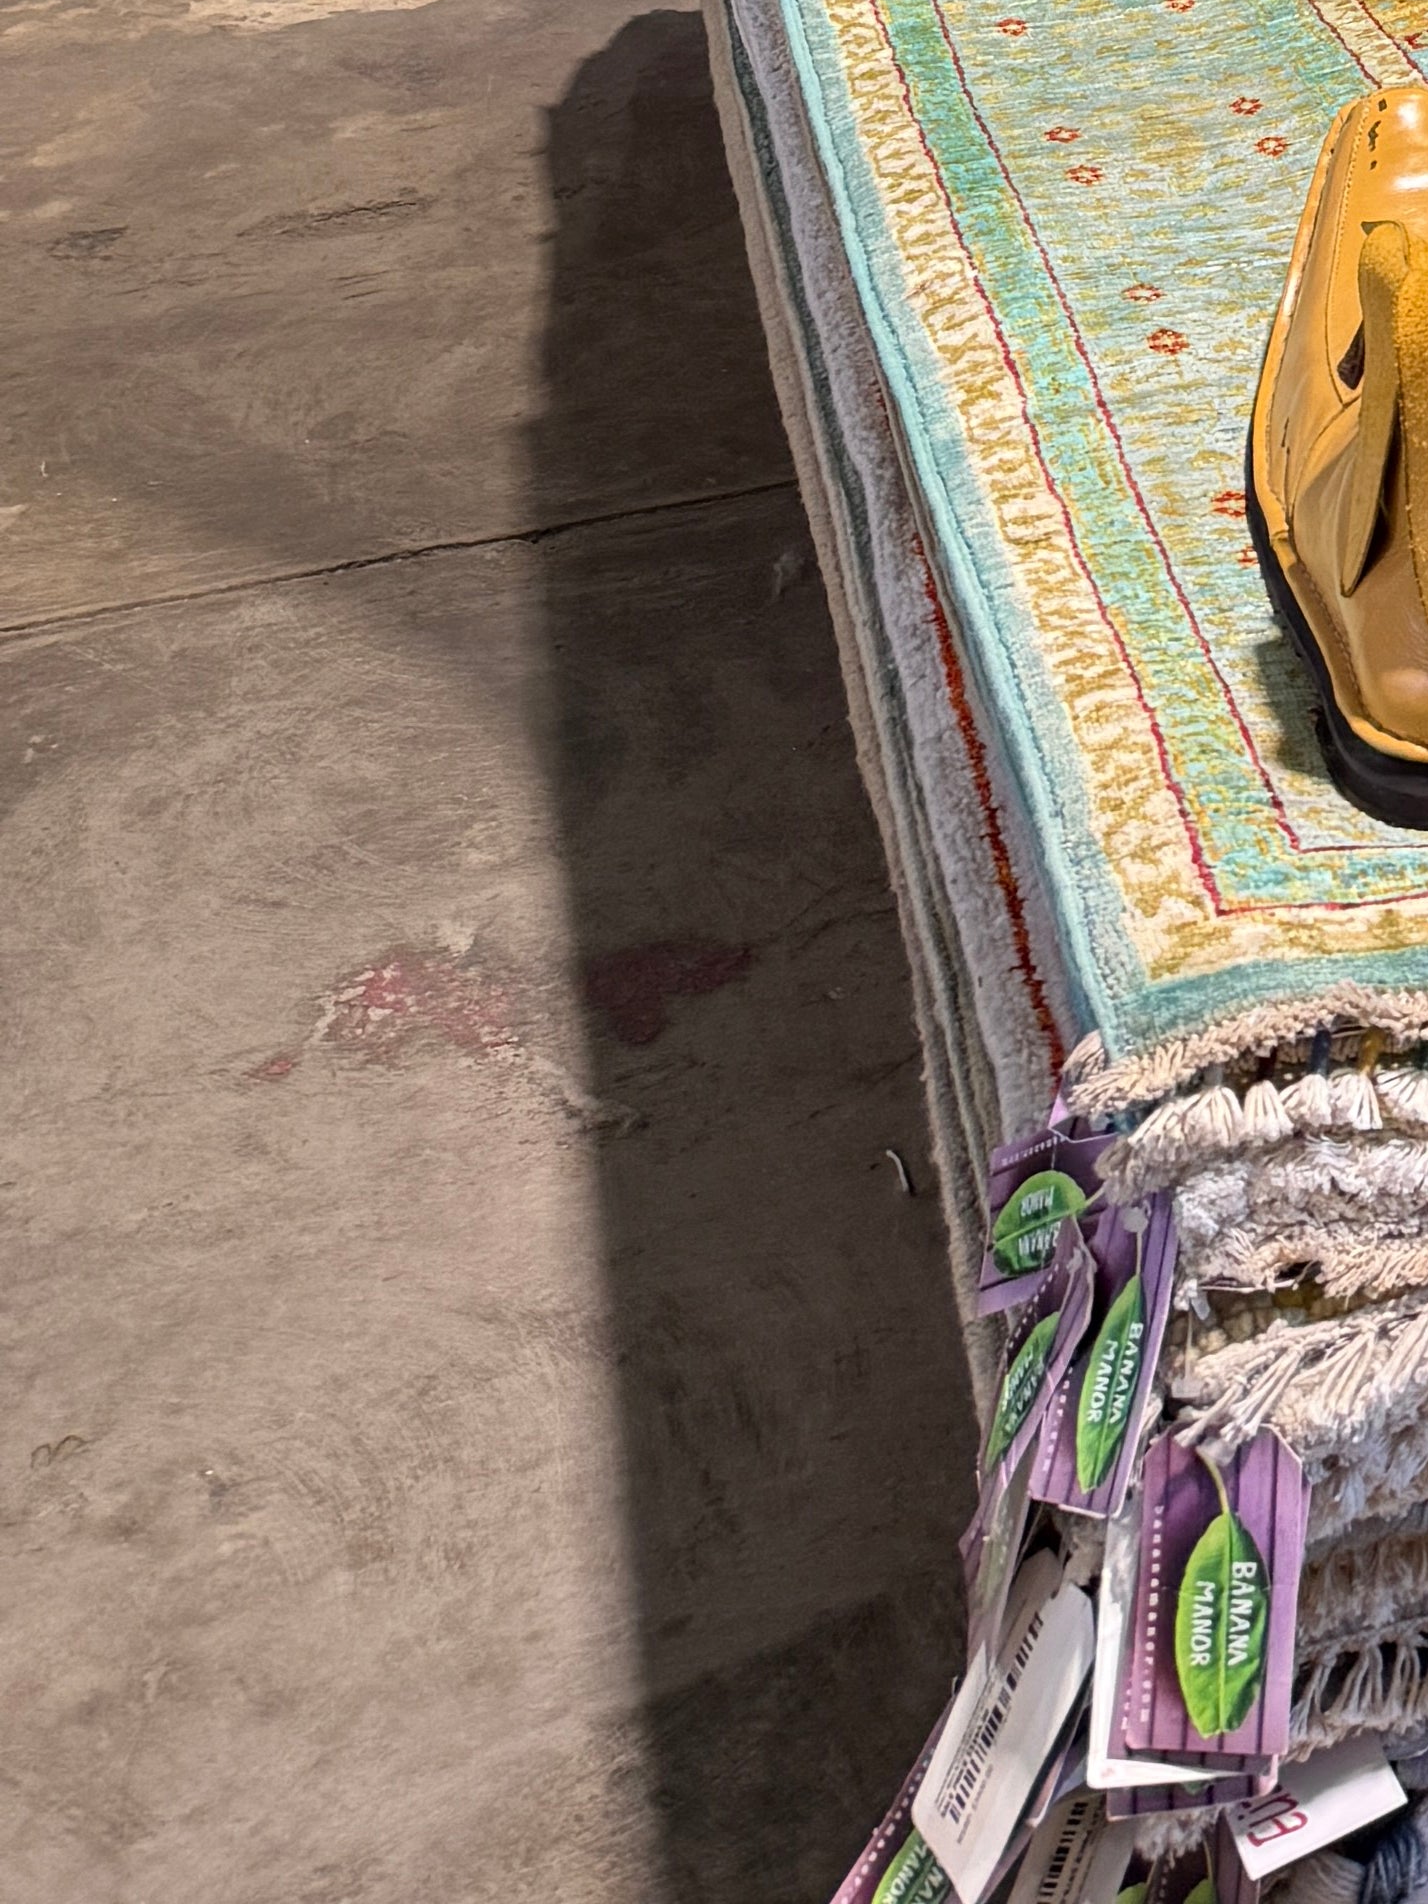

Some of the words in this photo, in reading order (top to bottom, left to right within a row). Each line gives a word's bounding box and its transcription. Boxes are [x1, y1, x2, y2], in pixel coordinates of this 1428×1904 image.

[1087, 1340, 1118, 1423] MANOR
[1109, 1322, 1144, 1424] BANANA
[1189, 1580, 1216, 1667] MANOR
[1226, 1561, 1258, 1667] BANANA
